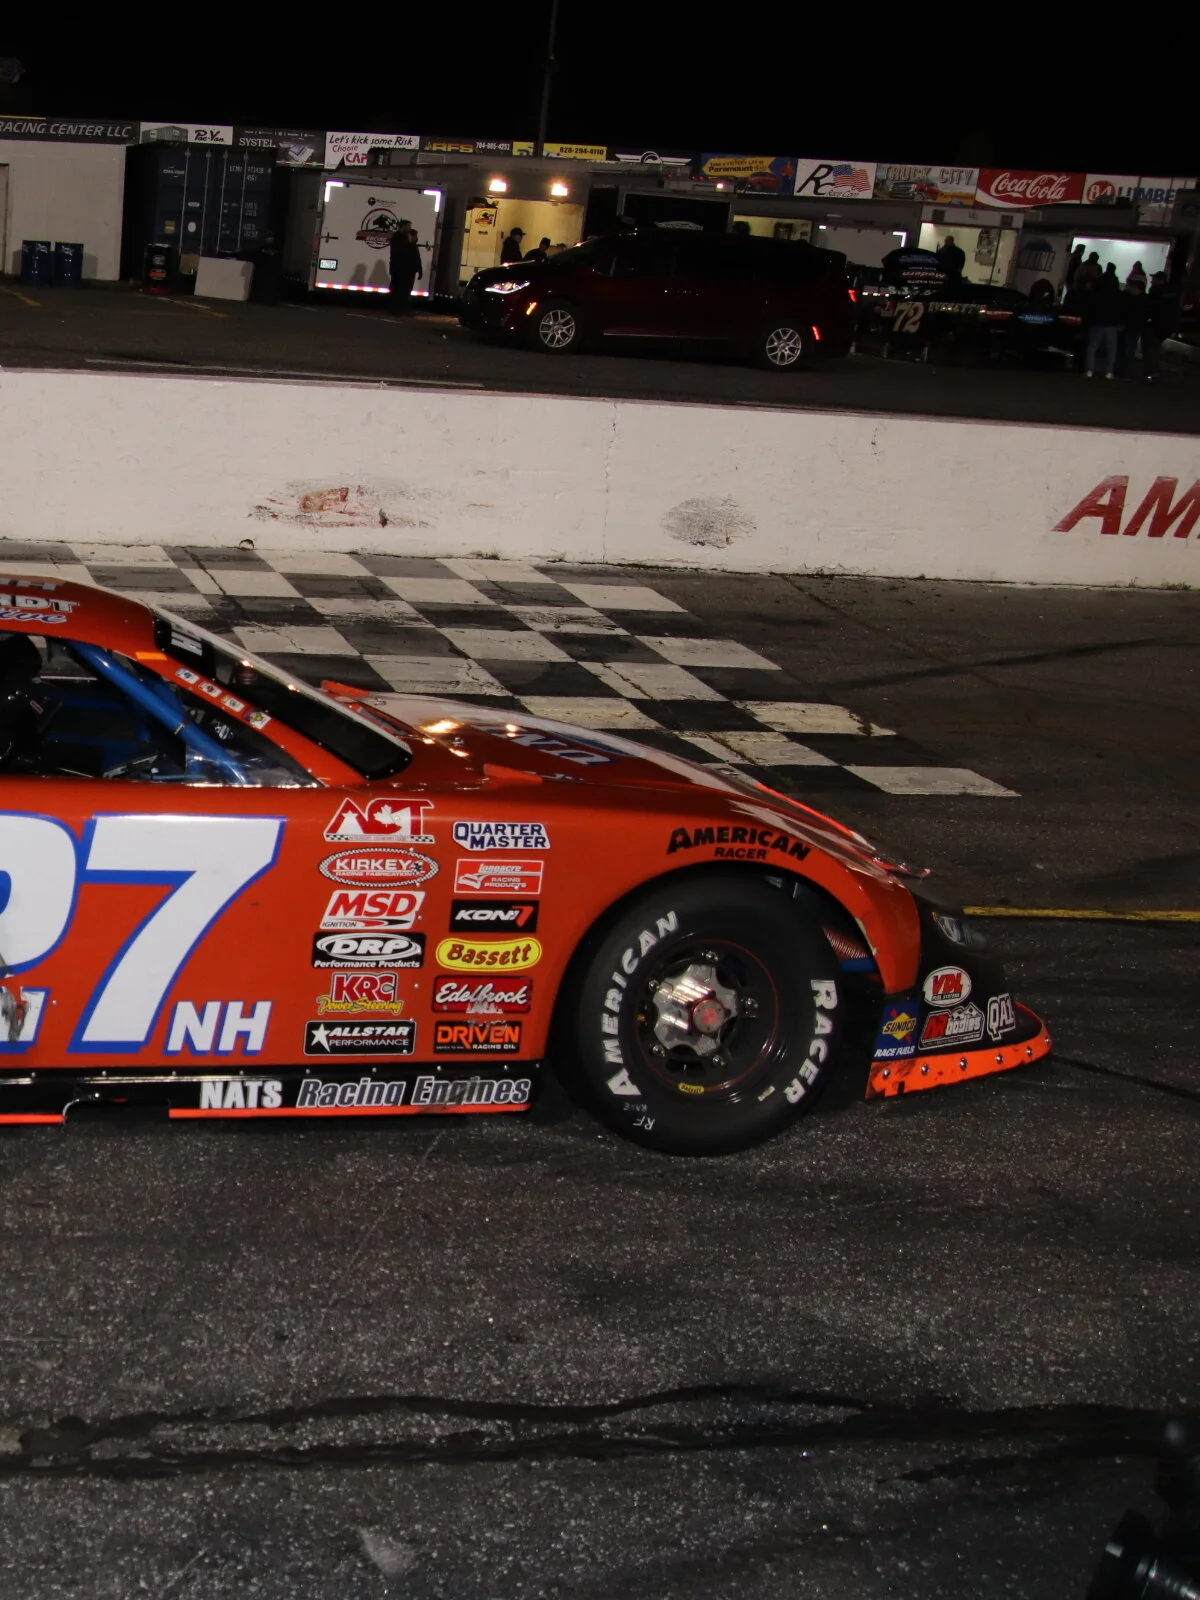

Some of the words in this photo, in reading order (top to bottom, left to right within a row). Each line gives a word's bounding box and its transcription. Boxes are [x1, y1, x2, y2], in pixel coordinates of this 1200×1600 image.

[50, 123, 103, 137] CENTER
[106, 126, 133, 138] LLC
[194, 129, 224, 143] Pac-Van
[239, 137, 277, 149] SYSTEL
[329, 134, 349, 145] Let's
[351, 134, 369, 145] kick
[371, 137, 393, 146] some
[394, 136, 414, 147] Risk
[708, 165, 753, 173] Paramount
[883, 165, 932, 182] TRUCK
[938, 167, 975, 185] CITY
[990, 171, 1072, 201] Coca-Cola
[891, 301, 925, 333] 72
[455, 822, 543, 841] QUARTER
[469, 836, 548, 850] MASTER
[666, 826, 812, 862] AMERICAN
[713, 846, 769, 861] RACER
[335, 858, 412, 871] KIRKEY
[327, 891, 418, 918] MSD
[321, 920, 358, 929] IGNITION
[329, 938, 409, 955] DRP
[445, 942, 533, 966] Bassett
[313, 960, 380, 969] Performance
[380, 959, 421, 969] Products
[331, 973, 398, 1002] KRC
[435, 982, 529, 1005] Edelbrock
[601, 910, 681, 1098] AMERICAN
[882, 1017, 918, 1034] SUNOCO
[989, 998, 1014, 1036] QA1
[163, 1000, 273, 1057] NH
[327, 1025, 411, 1038] ALLSTAR
[436, 1025, 521, 1049] DRIVEN
[328, 1037, 410, 1048] PERFORMANCE
[782, 979, 839, 1105] RACER
[874, 1047, 897, 1057] RACE
[897, 1045, 916, 1056] FUELS
[200, 1079, 283, 1110] NATS
[296, 1078, 405, 1108] Racing
[410, 1076, 532, 1107] Engines
